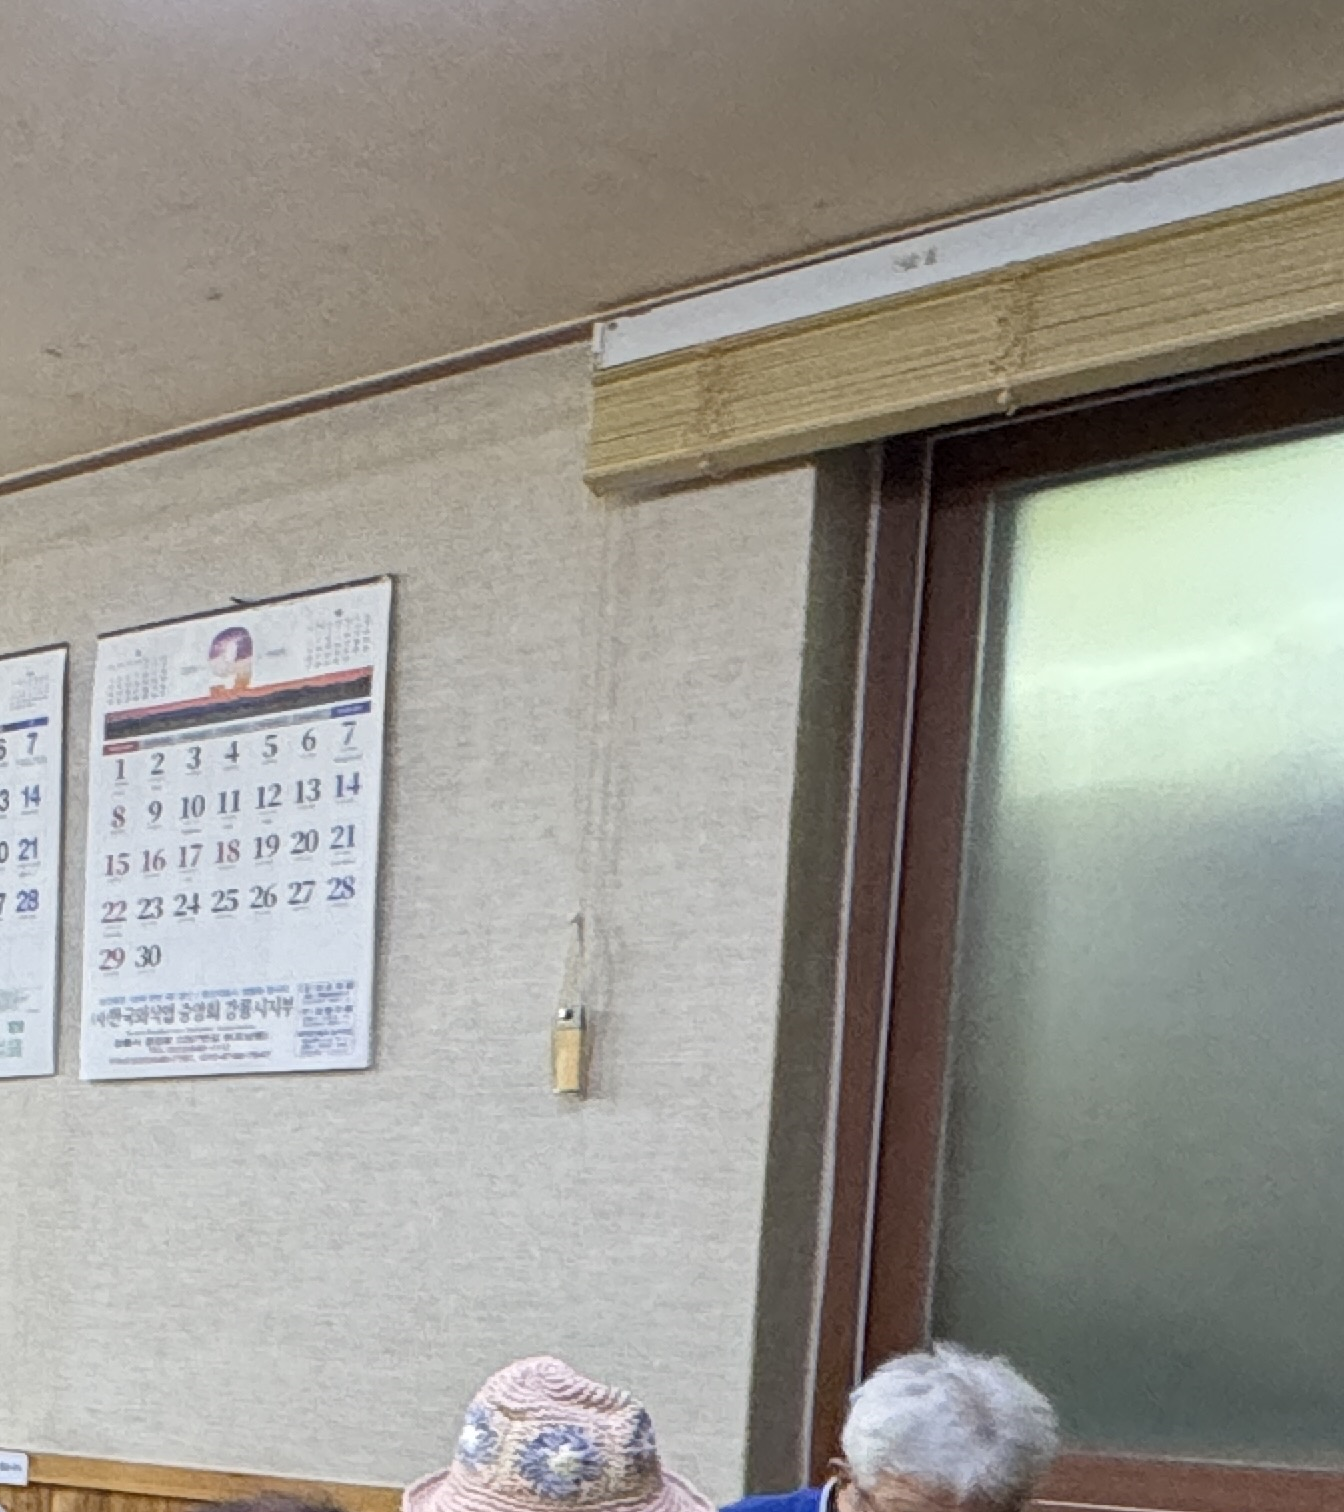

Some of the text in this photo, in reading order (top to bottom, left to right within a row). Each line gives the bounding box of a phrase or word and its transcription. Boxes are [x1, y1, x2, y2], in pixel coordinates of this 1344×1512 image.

[26, 731, 38, 756] 7
[116, 720, 358, 780] 1 2 3 4 5 6 7
[20, 784, 42, 808] 14
[112, 772, 360, 828] 8 9 10 11 12 13 14
[18, 836, 38, 861] 21
[104, 824, 355, 876] 15 16 17 18 19 20 21
[15, 888, 39, 913] 28
[100, 875, 356, 924] 22 23 24 25 26 27 28
[99, 944, 162, 969] 29 30
